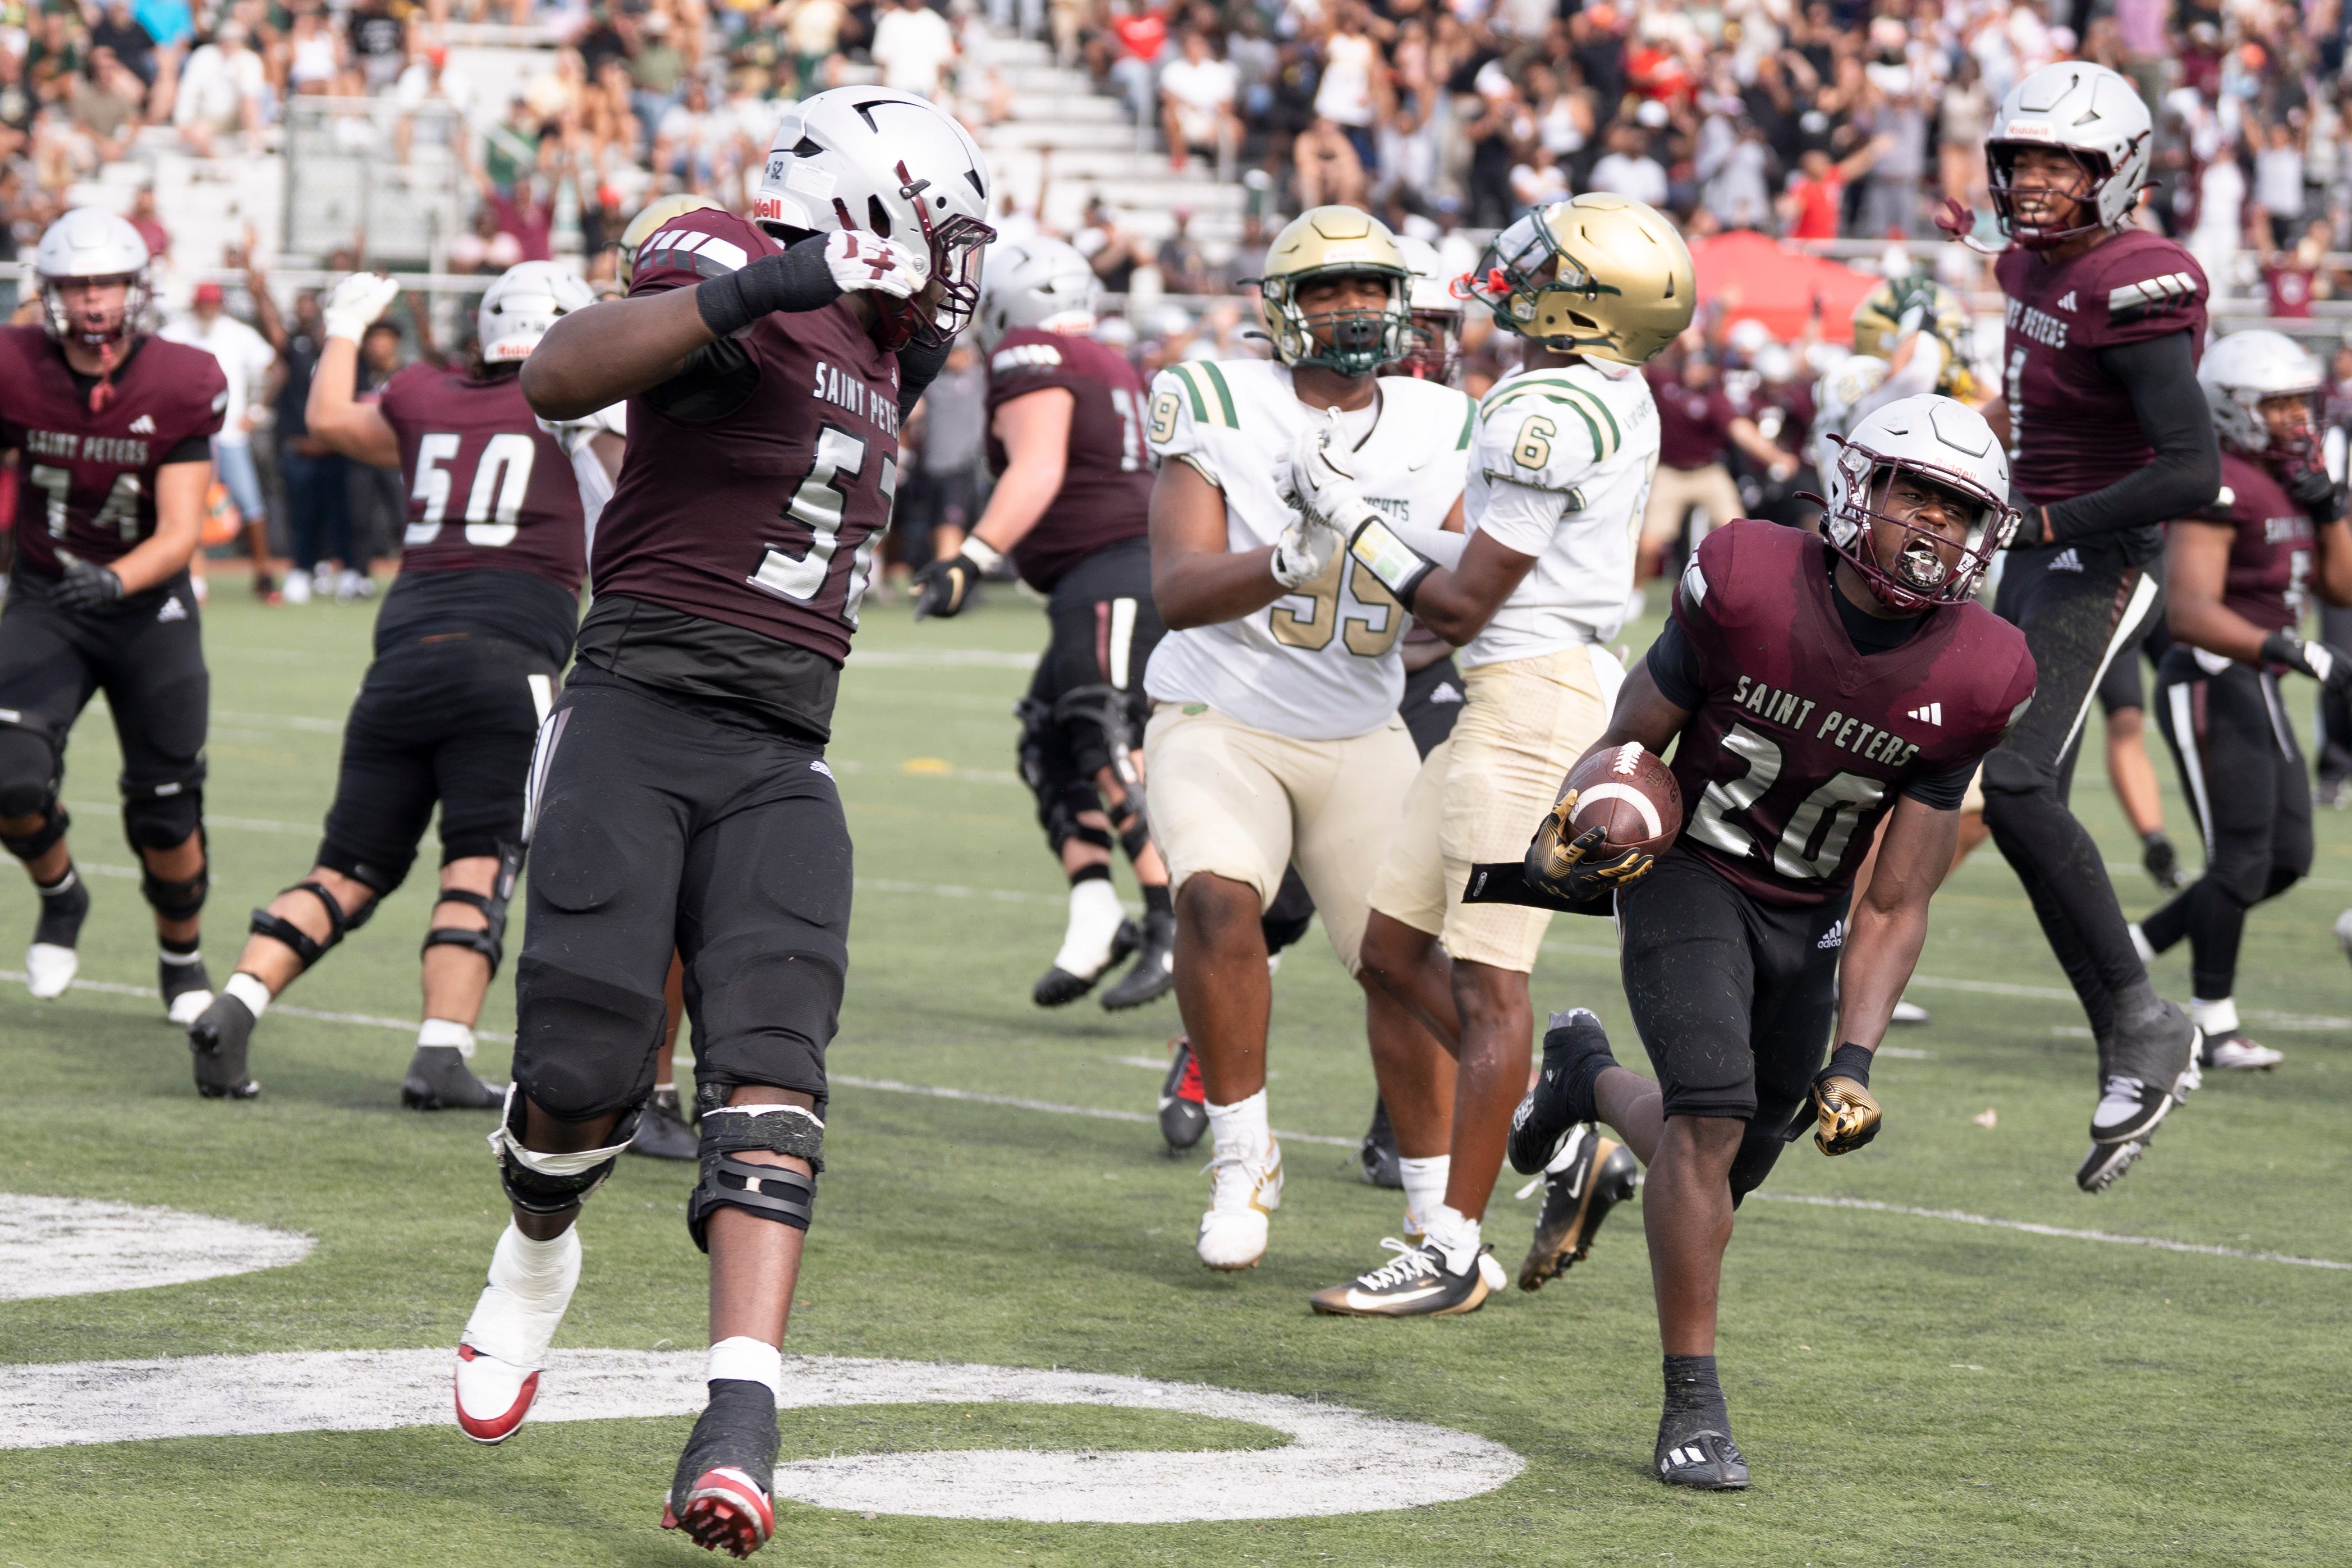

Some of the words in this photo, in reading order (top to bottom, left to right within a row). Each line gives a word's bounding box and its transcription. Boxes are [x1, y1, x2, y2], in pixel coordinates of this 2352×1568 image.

[813, 361, 864, 416] SAINT
[870, 389, 900, 442] PETE
[1149, 391, 1181, 444] 9
[1512, 415, 1556, 471] 6
[403, 432, 535, 547] 50
[1733, 675, 1816, 730] SAINT
[1816, 710, 1920, 767] PETERS
[1685, 722, 1887, 879] 20
